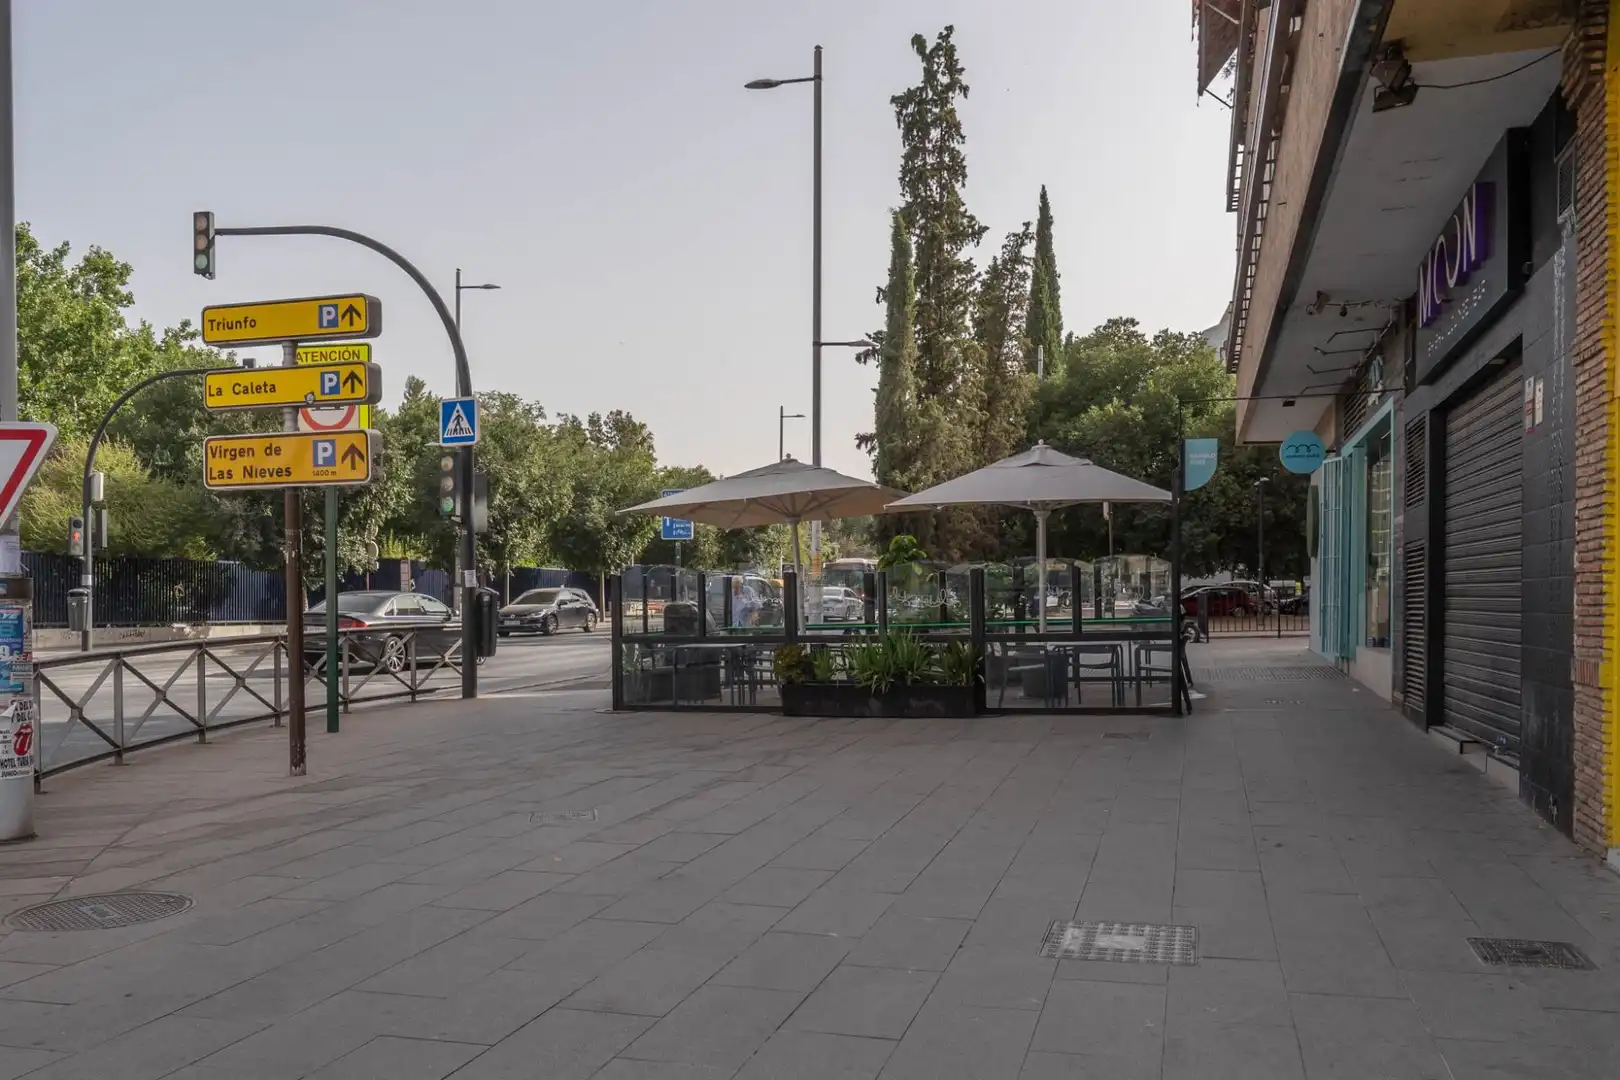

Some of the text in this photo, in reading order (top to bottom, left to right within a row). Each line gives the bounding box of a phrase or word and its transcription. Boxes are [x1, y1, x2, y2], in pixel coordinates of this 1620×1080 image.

[1419, 183, 1477, 329] MOON
[207, 316, 257, 332] Triunfo
[322, 306, 336, 327] P
[296, 346, 361, 362] ATENCIÓN
[208, 381, 276, 397] La Caleta
[324, 373, 338, 393] P
[209, 443, 282, 461] Virgen de
[317, 442, 333, 465] P
[209, 465, 292, 481] Las Nieves
